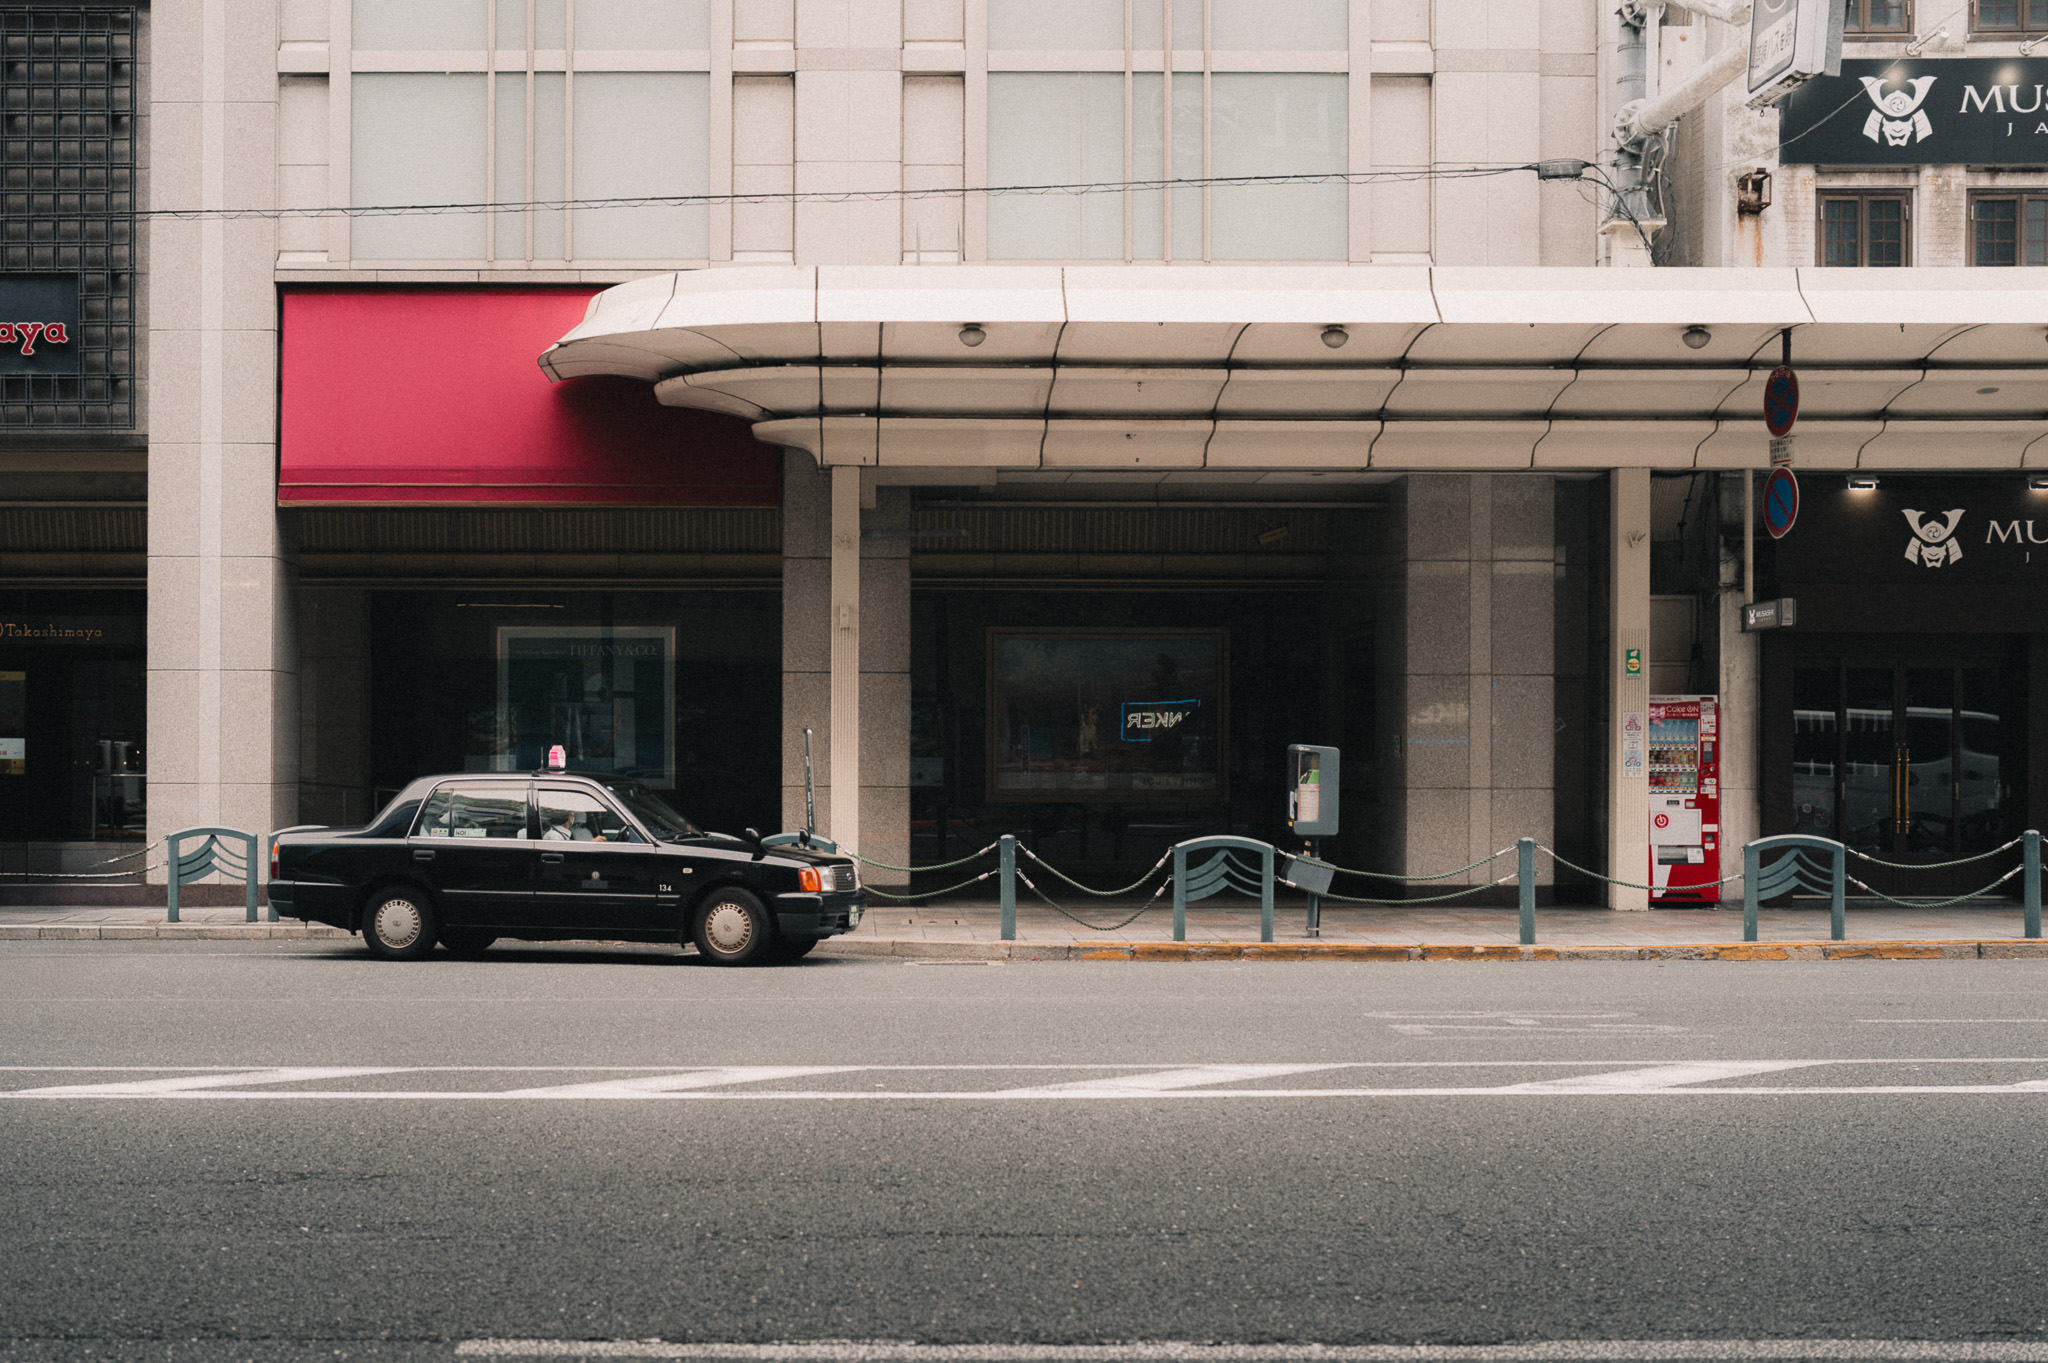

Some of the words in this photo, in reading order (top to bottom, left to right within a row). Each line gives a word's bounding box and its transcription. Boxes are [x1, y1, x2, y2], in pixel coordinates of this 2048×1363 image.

[1959, 84, 2048, 113] MU
[0, 322, 69, 355] aya
[5, 623, 103, 641] Takashimaya
[1666, 705, 1686, 713] Coke
[659, 884, 672, 892] 134
